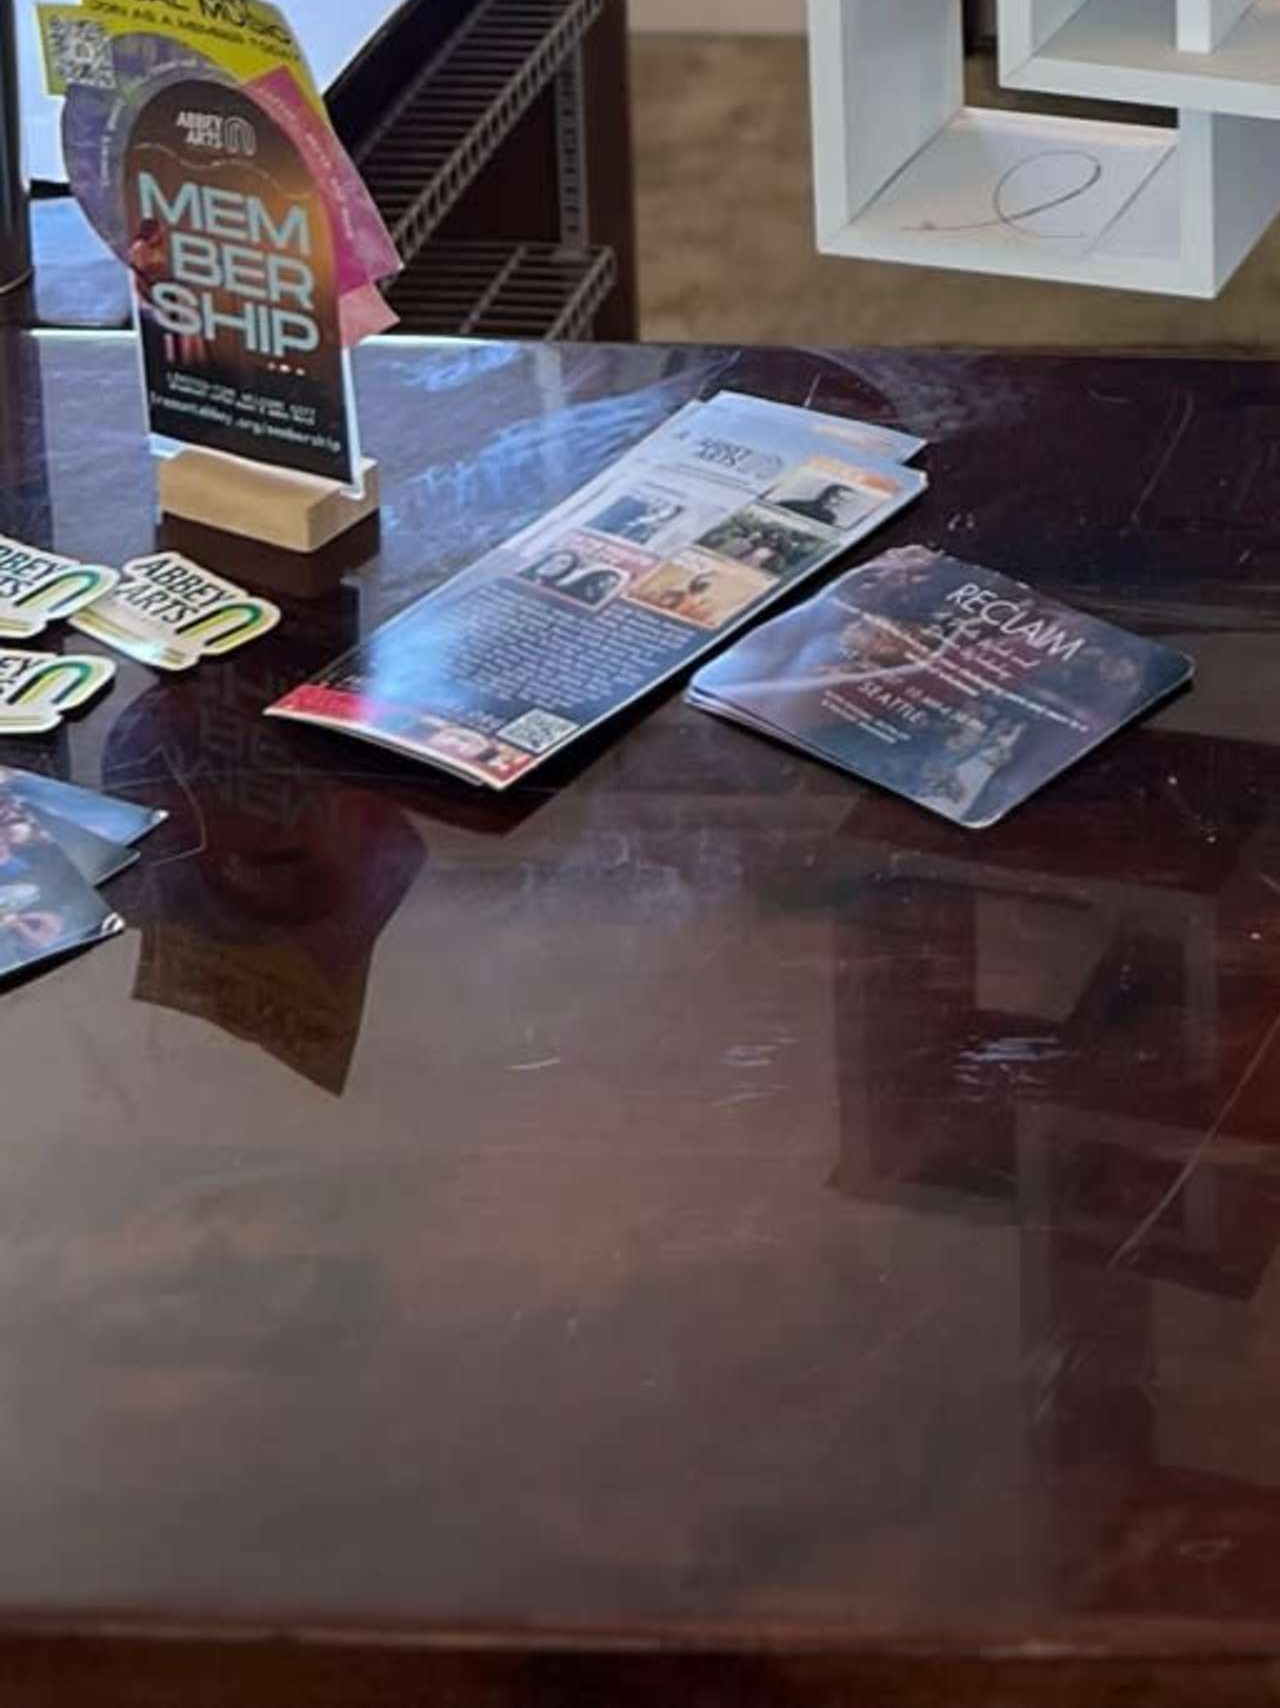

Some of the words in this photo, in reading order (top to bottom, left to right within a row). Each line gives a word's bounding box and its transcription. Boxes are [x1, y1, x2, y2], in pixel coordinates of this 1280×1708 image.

[138, 171, 311, 256] MEM
[170, 232, 315, 310] BER
[152, 281, 320, 357] SHIP
[118, 581, 200, 626] ARTS
[133, 556, 238, 605] ABBEY
[946, 582, 1085, 662] RECLAIM
[857, 681, 927, 726] SEATTLE
